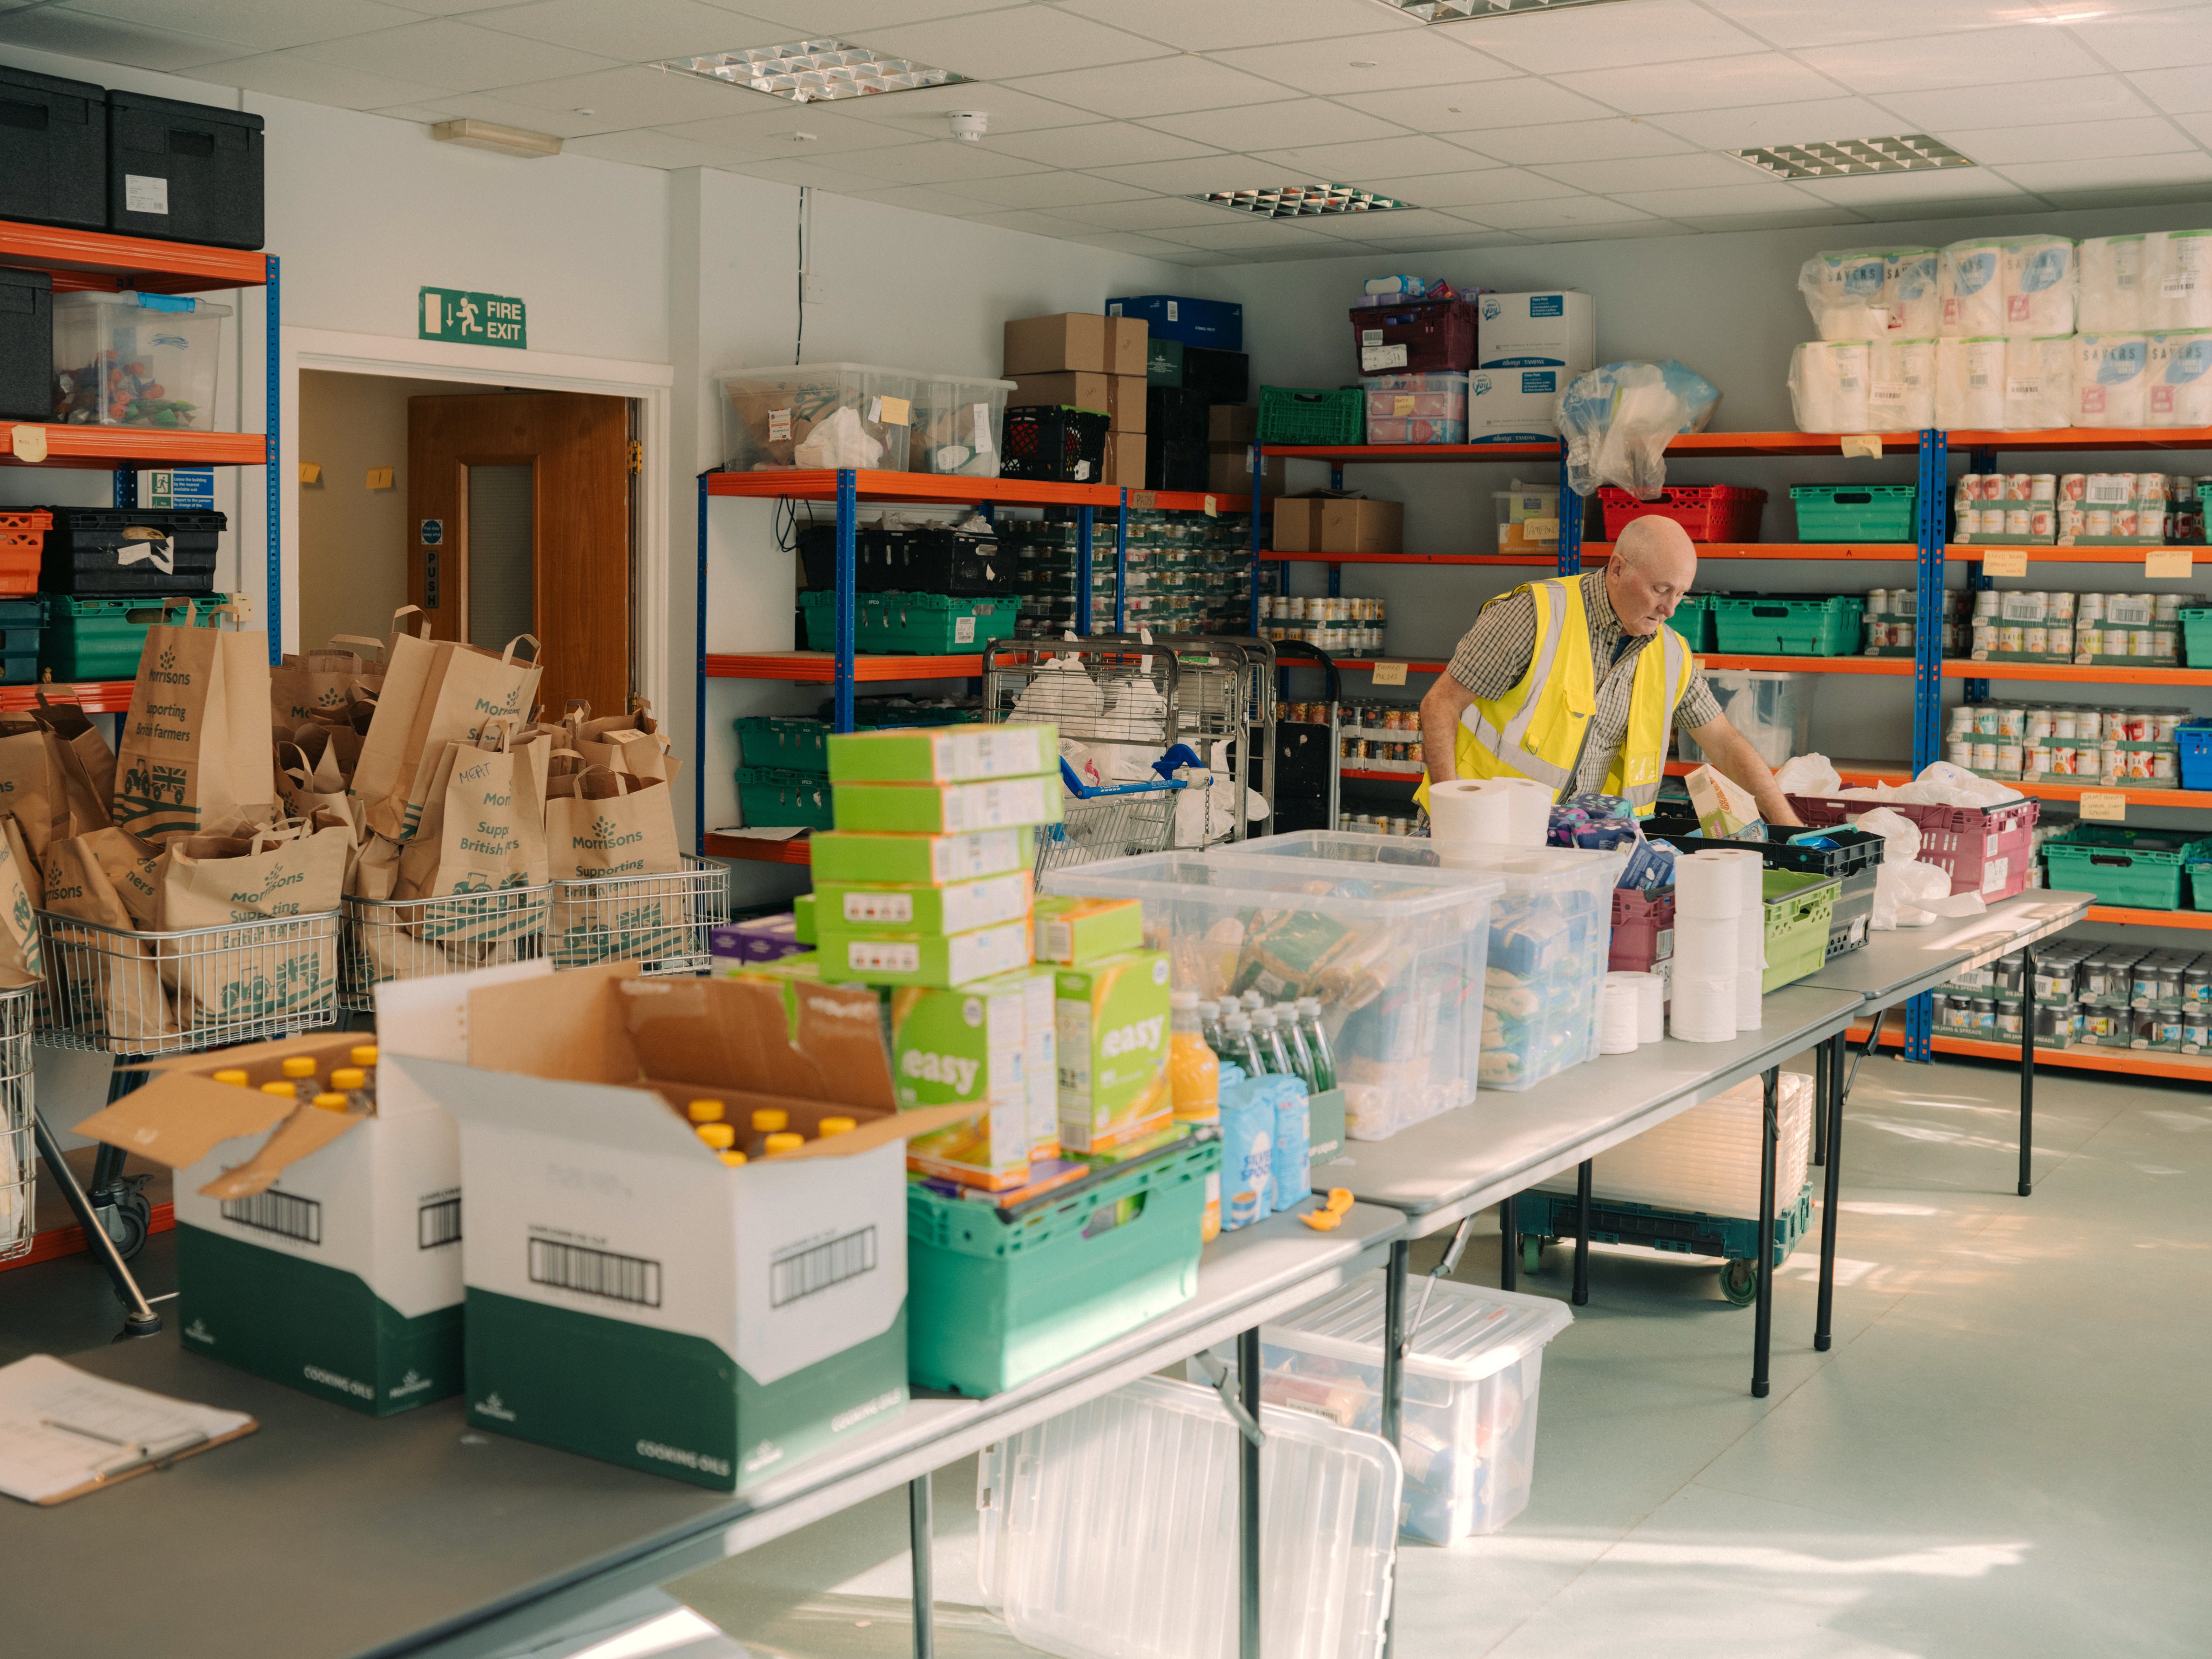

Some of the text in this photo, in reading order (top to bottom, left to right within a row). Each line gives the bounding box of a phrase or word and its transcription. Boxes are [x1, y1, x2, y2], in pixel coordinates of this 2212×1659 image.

[1827, 269, 1876, 282] SAVERS
[487, 301, 521, 320] FIRE
[487, 322, 521, 340] EXIT
[2083, 348, 2135, 361] SAVERS
[2153, 346, 2202, 359] SAVERS
[1136, 494, 1152, 505] PADS
[1525, 521, 1559, 538] TAMPONS
[428, 552, 436, 606] PUSH
[149, 668, 190, 685] Morrisons
[154, 723, 190, 741] farmers
[460, 762, 490, 784] MEAT
[460, 838, 503, 856] British
[572, 831, 643, 849] Morrisons
[576, 859, 644, 878] Supporting
[230, 902, 300, 923] Suppting
[1101, 1015, 1164, 1058] easy
[902, 1049, 980, 1095] easy
[304, 1366, 375, 1400] COOKING OILS
[832, 1388, 901, 1432] COOKING OILS
[636, 1439, 730, 1476] COOKING OILS
